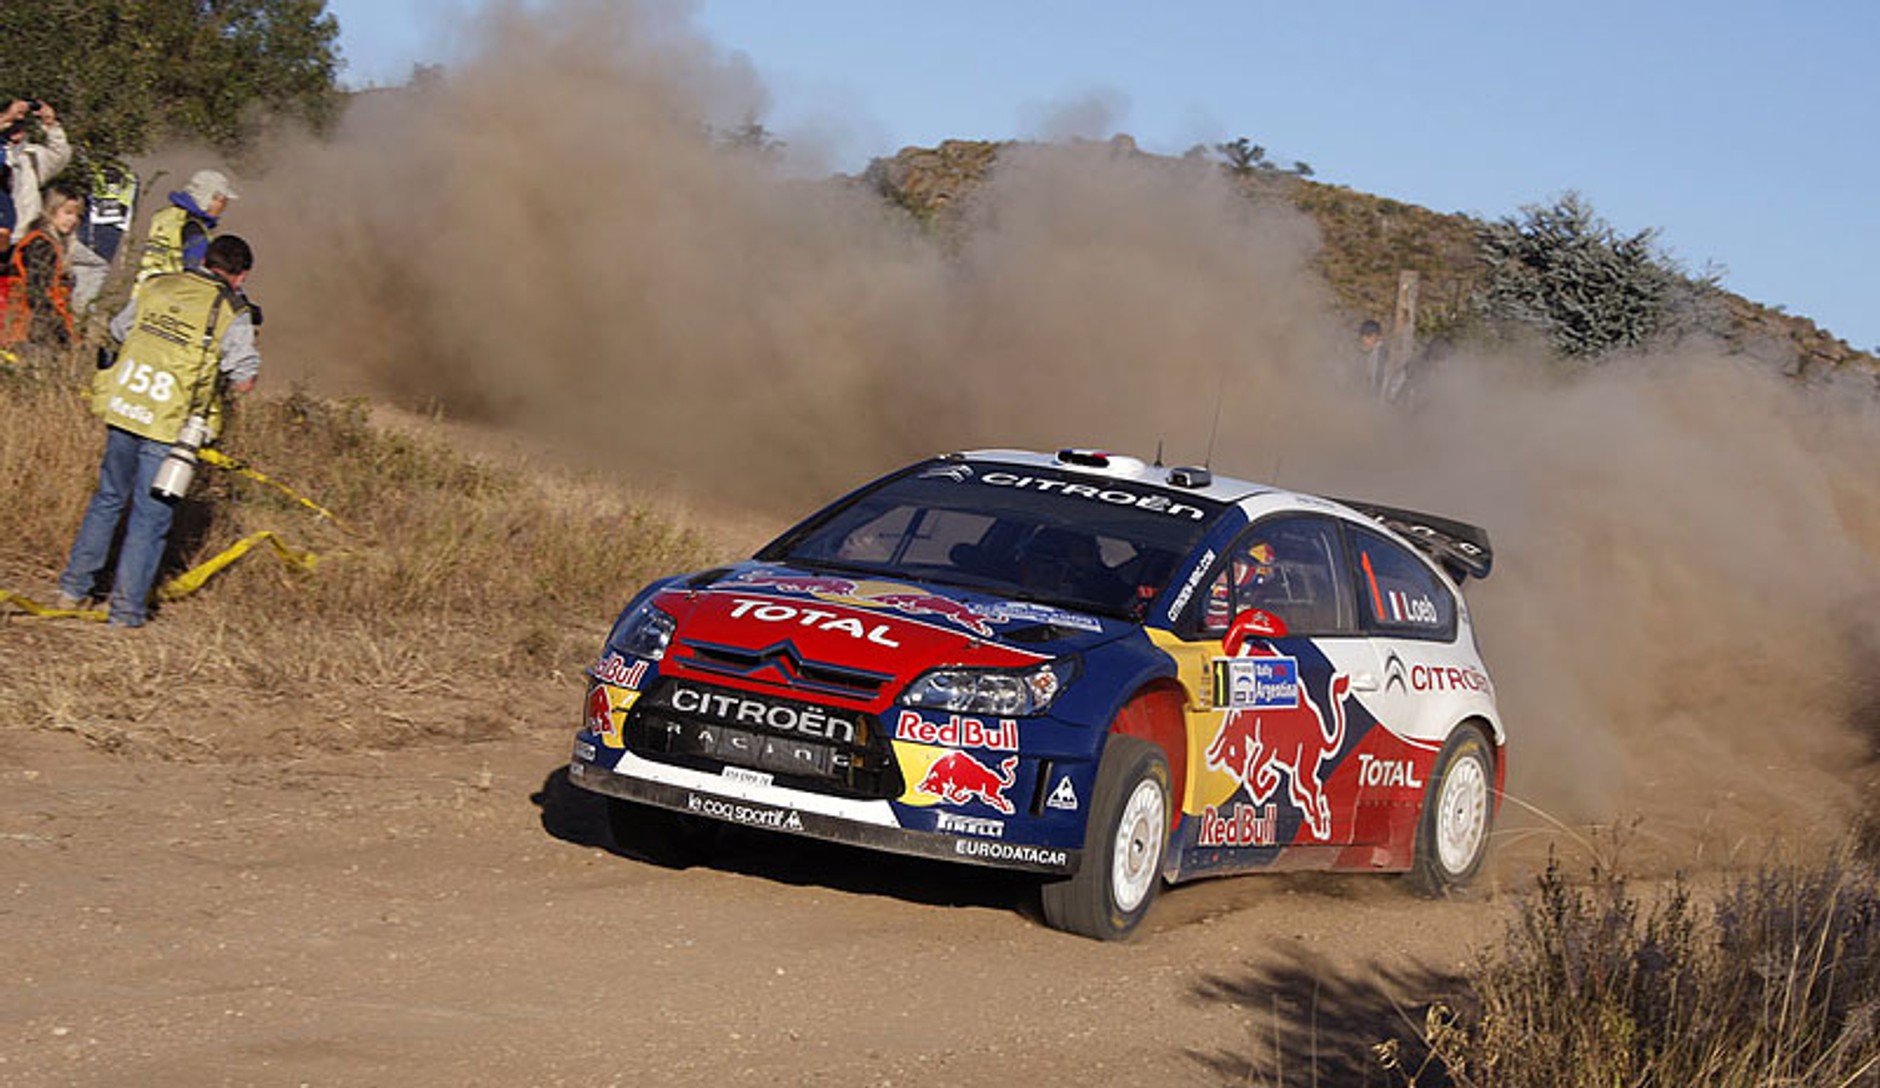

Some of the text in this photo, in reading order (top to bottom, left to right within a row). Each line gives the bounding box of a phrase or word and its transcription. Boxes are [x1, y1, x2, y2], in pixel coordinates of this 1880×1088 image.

[118, 358, 176, 403] 158
[730, 598, 900, 648] TOTAL
[1402, 590, 1438, 624] Loeb
[896, 710, 1019, 752] Red Bull
[1358, 753, 1423, 790] TOTAL
[703, 800, 734, 821] coq
[735, 805, 785, 827] sportif
[1199, 802, 1278, 846] Red Bull
[955, 839, 1067, 866] EURODATACAR
